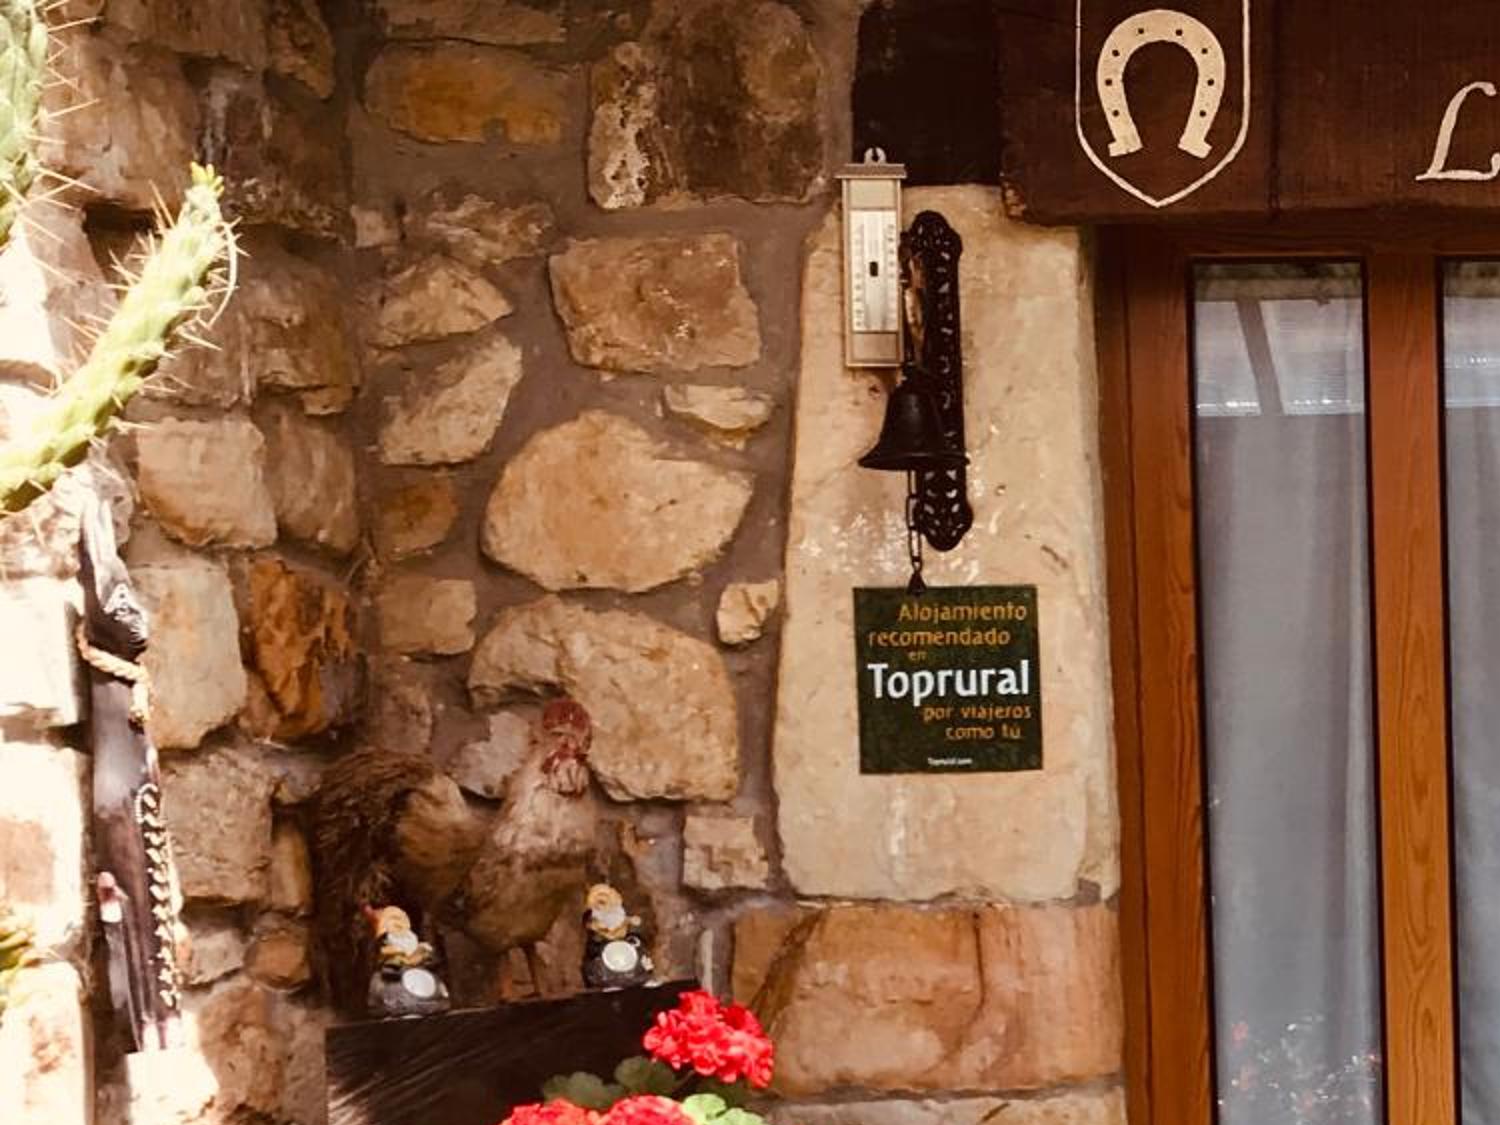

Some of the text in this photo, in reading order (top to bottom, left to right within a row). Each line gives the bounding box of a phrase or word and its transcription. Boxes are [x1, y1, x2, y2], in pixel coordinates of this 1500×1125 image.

[898, 601, 1027, 624] Alojamiento
[868, 627, 1011, 648] recomendado
[867, 659, 1029, 707] Toprural
[923, 703, 1032, 722] por viajeros
[945, 726, 994, 740] como
